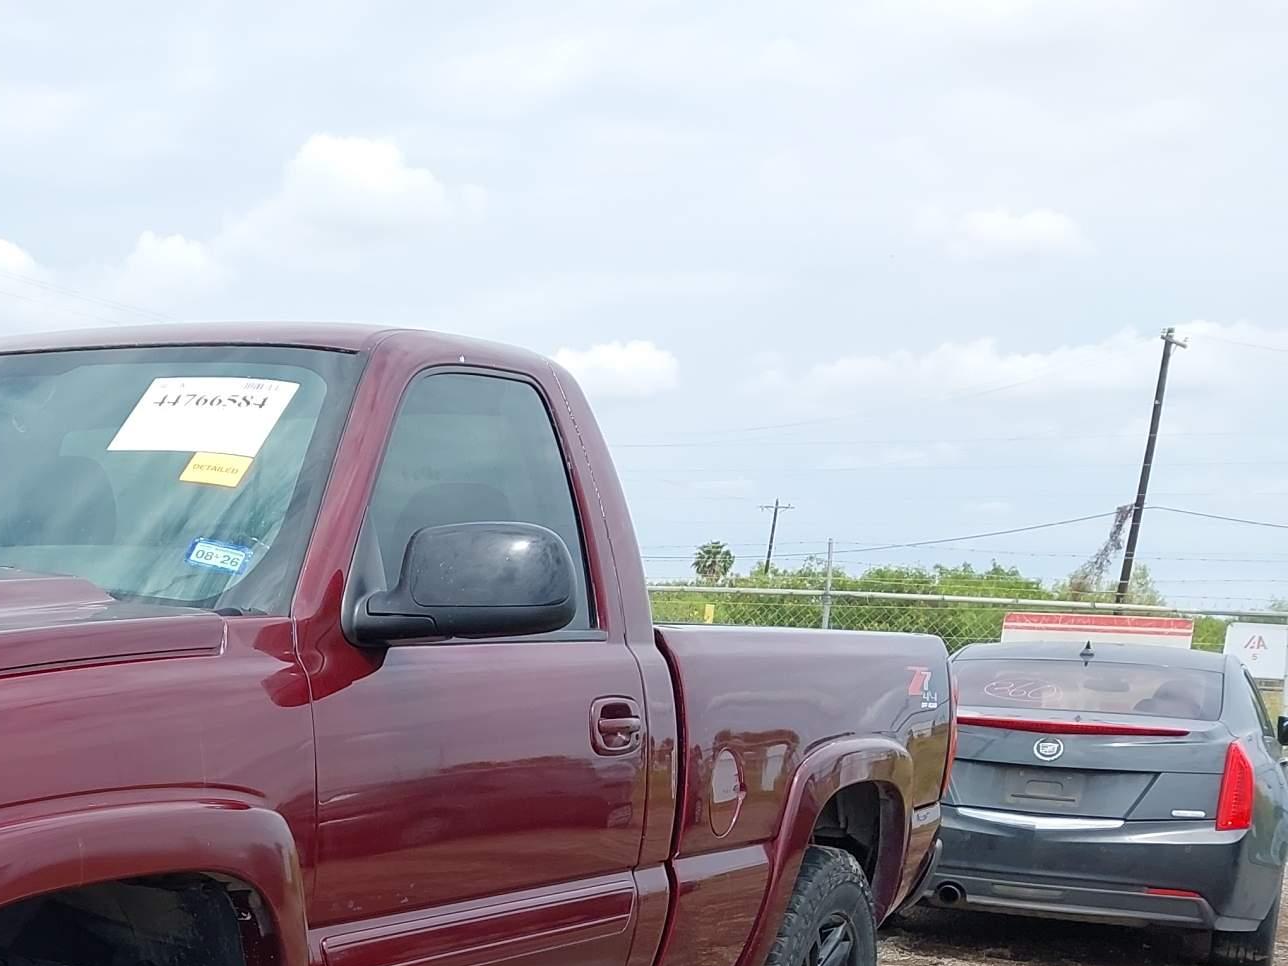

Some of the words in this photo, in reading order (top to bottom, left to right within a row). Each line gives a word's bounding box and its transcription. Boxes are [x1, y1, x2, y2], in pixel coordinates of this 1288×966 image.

[153, 393, 269, 409] 44766584
[192, 463, 239, 475] DETAILED
[195, 549, 214, 561] 08
[219, 554, 240, 567] 26
